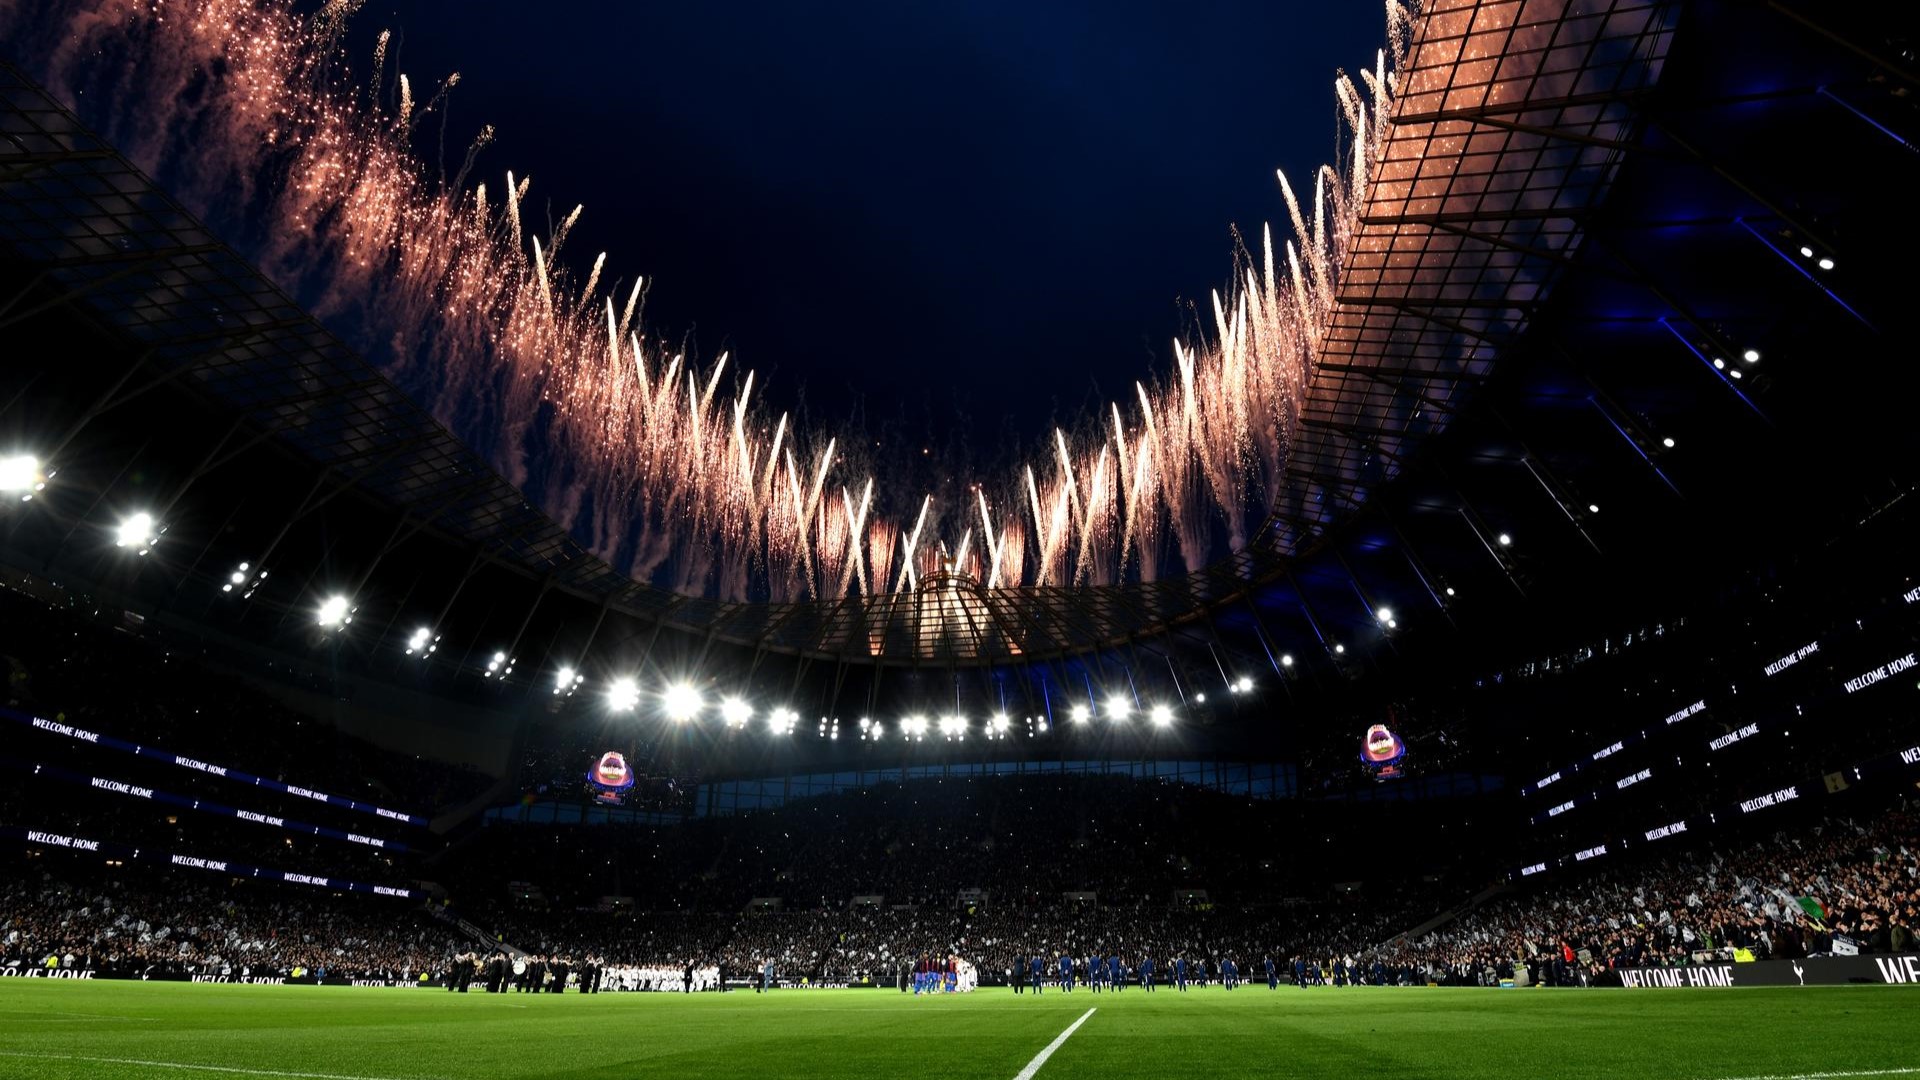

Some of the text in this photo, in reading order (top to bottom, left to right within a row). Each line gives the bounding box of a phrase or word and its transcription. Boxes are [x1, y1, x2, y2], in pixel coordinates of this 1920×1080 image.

[1904, 586, 1920, 604] WE
[1764, 641, 1820, 676] WELCOME HOME
[1844, 653, 1918, 693] WELCOME HOME
[33, 717, 99, 743] WELCOME HOME
[1710, 722, 1759, 751] WELCOME HOME
[176, 756, 227, 776] WELCOME HOME
[92, 777, 154, 799] WELCOME HOME
[287, 785, 328, 802] WELCOME HOME
[1740, 786, 1799, 813] WELCOME HOME
[237, 810, 283, 827] WELCOME HOME
[1645, 820, 1687, 841] WELCOME HOME
[28, 831, 100, 851] WELCOME HOME
[172, 855, 227, 871] WELCOME HOME
[284, 872, 328, 886] WELCOME HOME
[47, 969, 96, 980] HOME
[253, 976, 286, 985] HOME
[1619, 966, 1735, 988] WELCOME HOME
